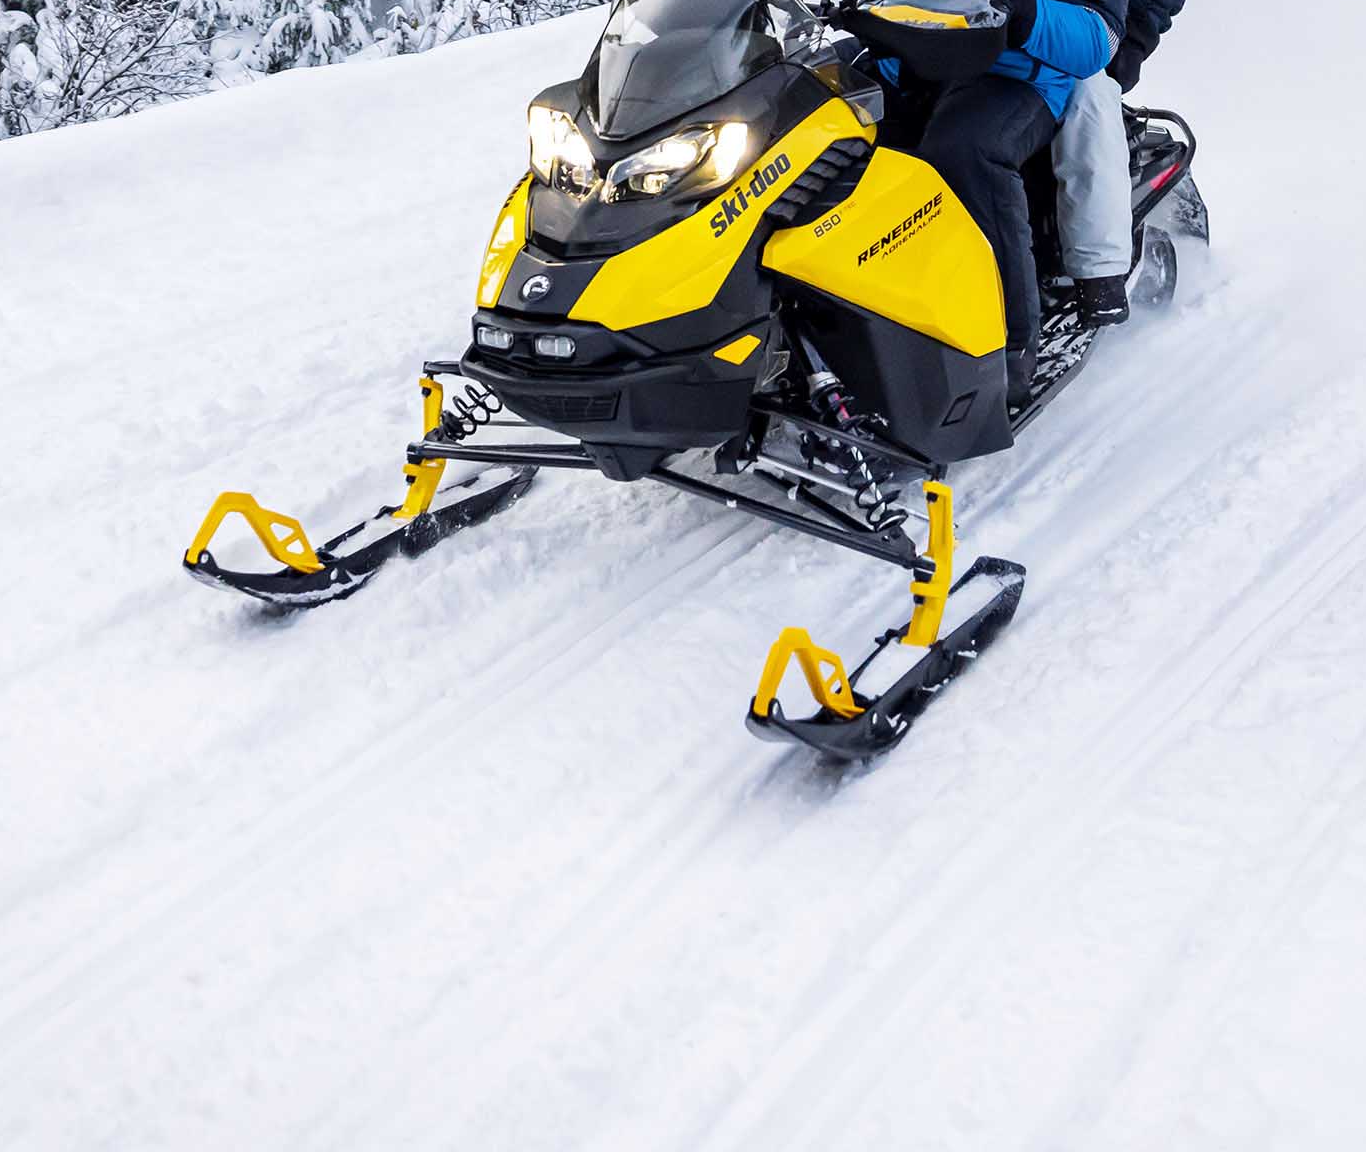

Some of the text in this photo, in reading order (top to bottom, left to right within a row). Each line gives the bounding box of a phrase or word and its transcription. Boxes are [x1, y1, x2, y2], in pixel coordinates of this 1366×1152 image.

[710, 153, 791, 238] ski-doo
[813, 214, 841, 238] 850
[858, 192, 943, 267] RENEGADE
